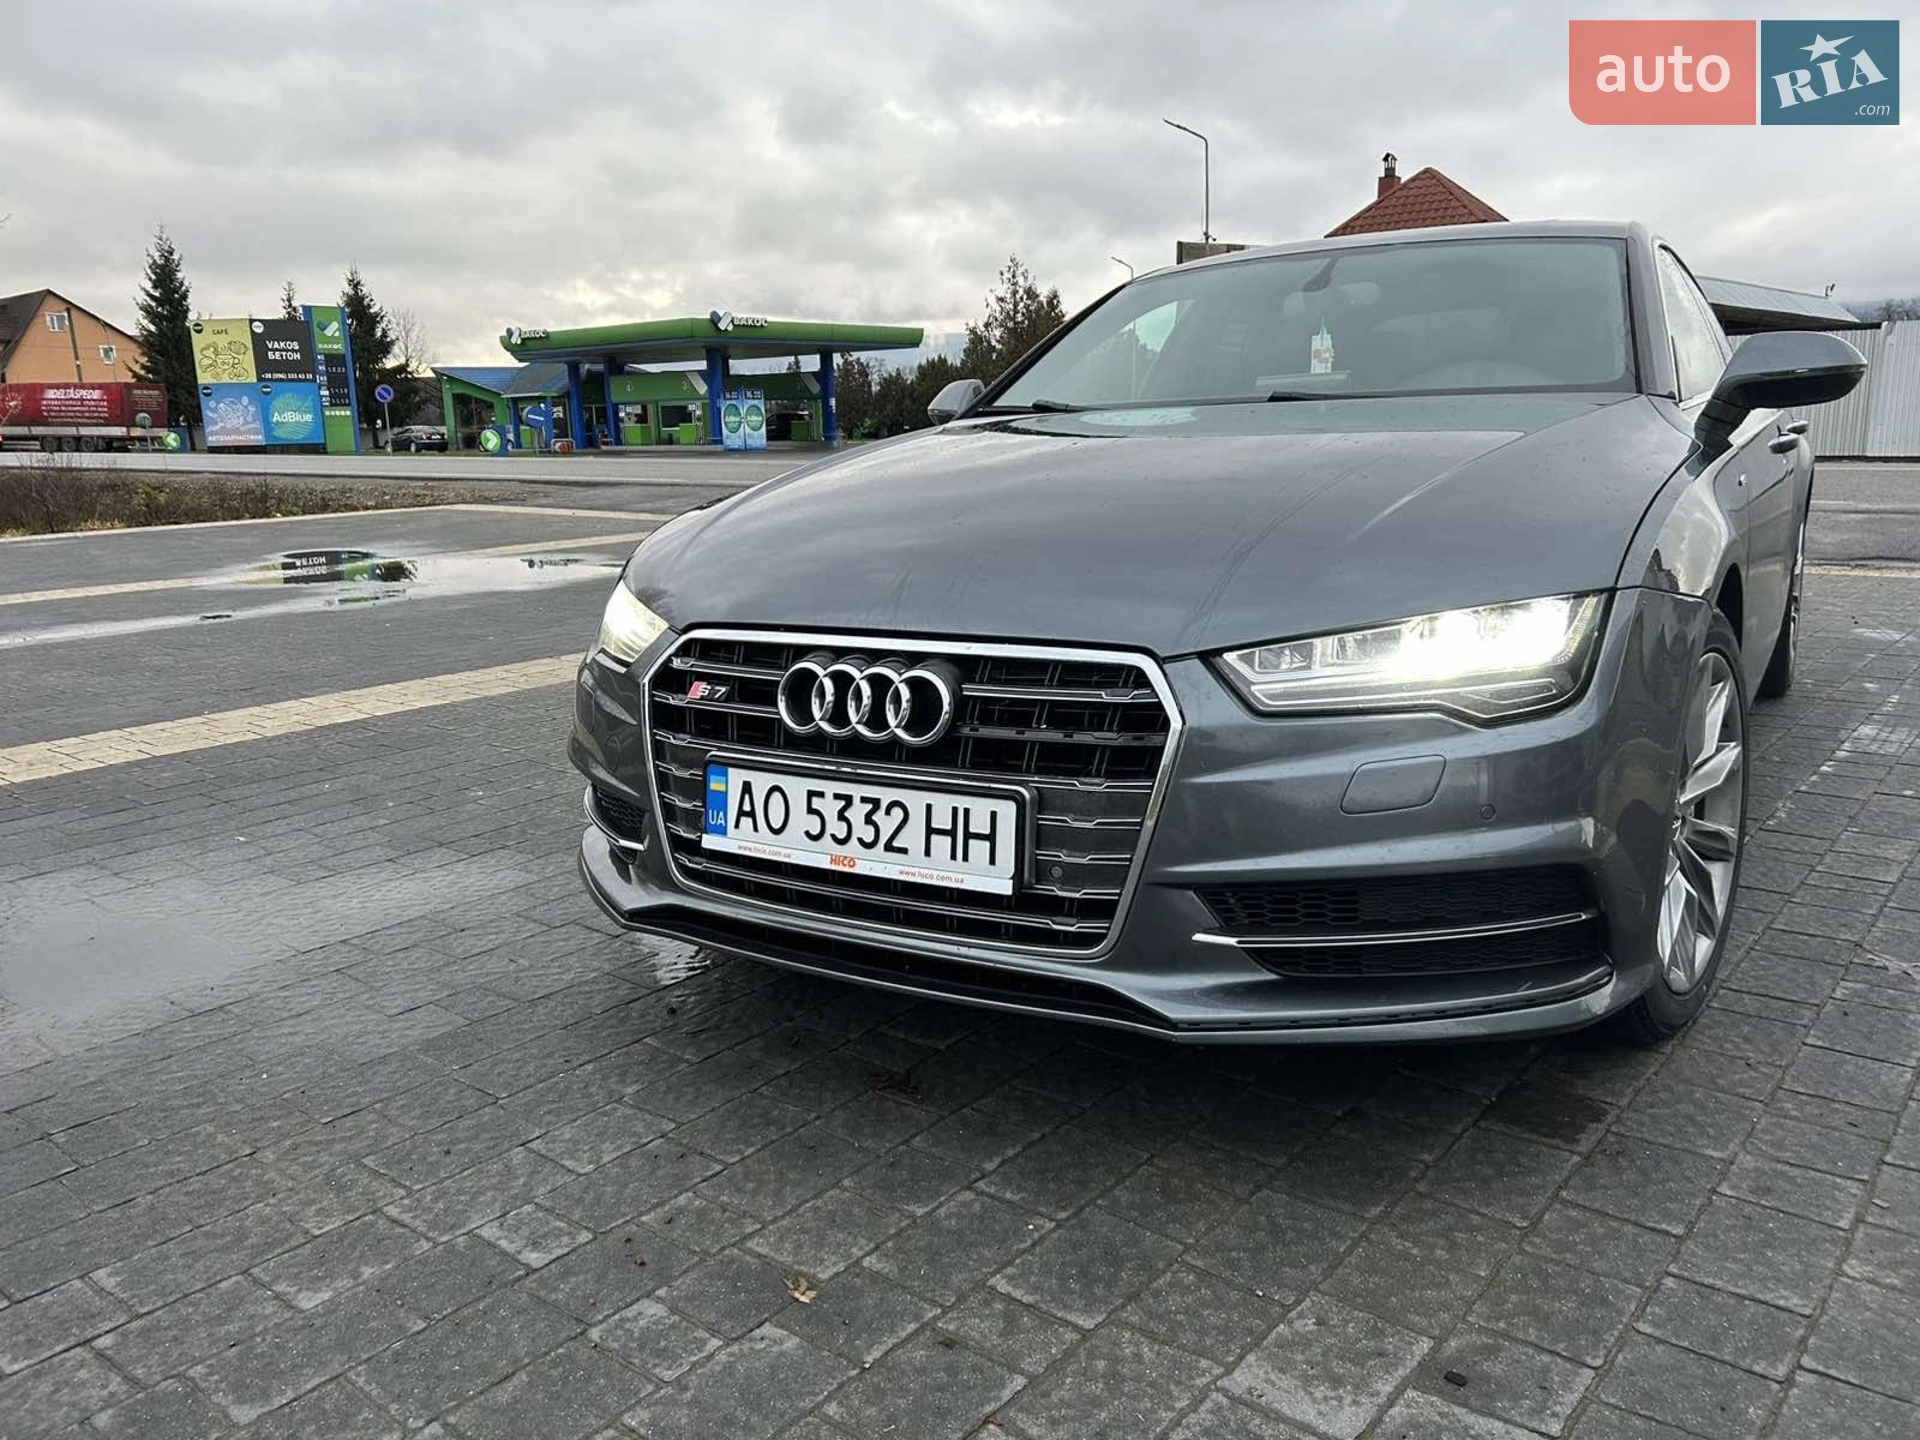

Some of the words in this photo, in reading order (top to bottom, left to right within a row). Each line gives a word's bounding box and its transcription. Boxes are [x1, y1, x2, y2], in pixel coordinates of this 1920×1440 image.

[265, 340, 300, 350] VAKOS
[268, 351, 301, 361] БЕТОН
[273, 411, 312, 423] AdBlue
[708, 809, 726, 827] UA
[734, 780, 790, 836] AO
[803, 789, 910, 856] 5332
[924, 802, 998, 867] HH
[829, 854, 857, 869] HICO
